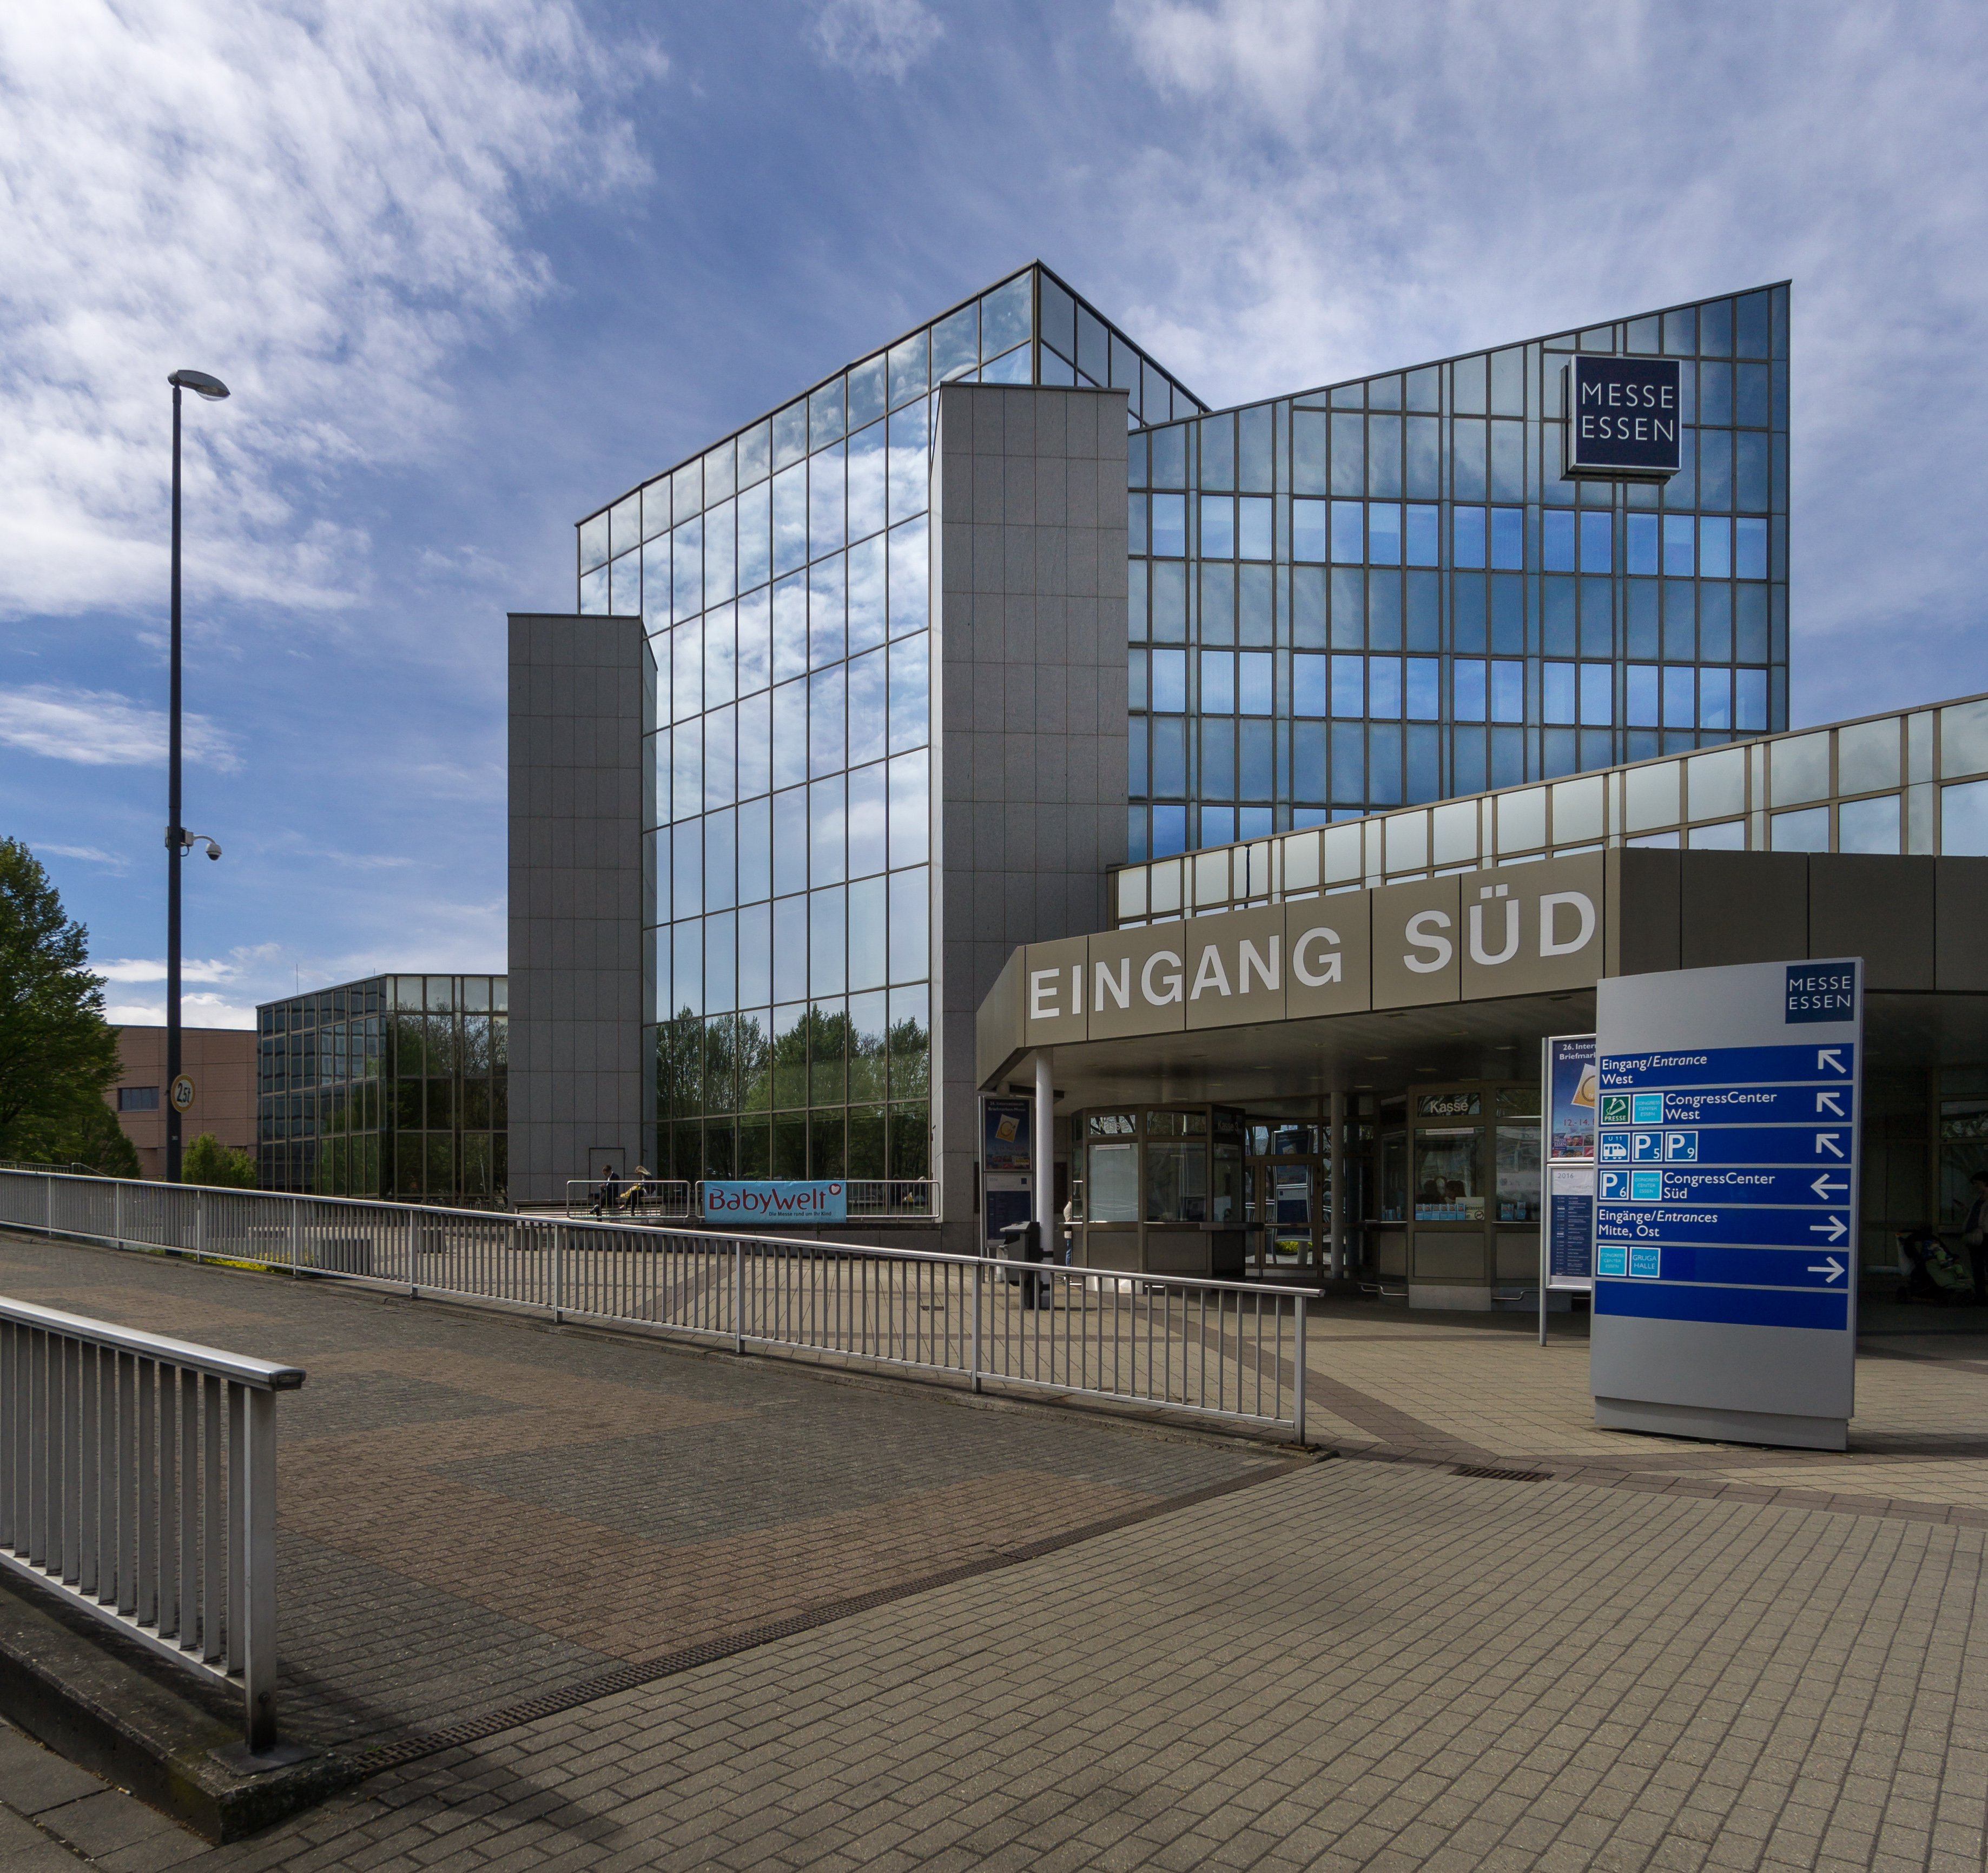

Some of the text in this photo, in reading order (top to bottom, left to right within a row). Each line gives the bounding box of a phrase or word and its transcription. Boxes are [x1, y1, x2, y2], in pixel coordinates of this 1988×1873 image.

[1582, 382, 1673, 408] MESSE
[1582, 415, 1673, 442] ESSEN
[1029, 884, 1597, 1021] EINGANG SÜD
[1790, 976, 1851, 991] MESSE
[1790, 995, 1850, 1010] ESSEN
[1602, 1056, 1707, 1072] Eingang/Entrance
[1602, 1074, 1633, 1085] West
[1430, 1101, 1468, 1114] Kasse
[1666, 1092, 1777, 1108] CongressCenter
[1666, 1108, 1701, 1120] West
[1635, 1135, 1660, 1159] P 5
[1668, 1134, 1695, 1159] P 9
[1602, 1173, 1627, 1197] P 6
[1664, 1172, 1775, 1187] CongressCenter
[1663, 1187, 1687, 1199] Süd
[1599, 1209, 1718, 1225] Eingänge/Entrances
[1599, 1224, 1660, 1239] Mitte, Ost
